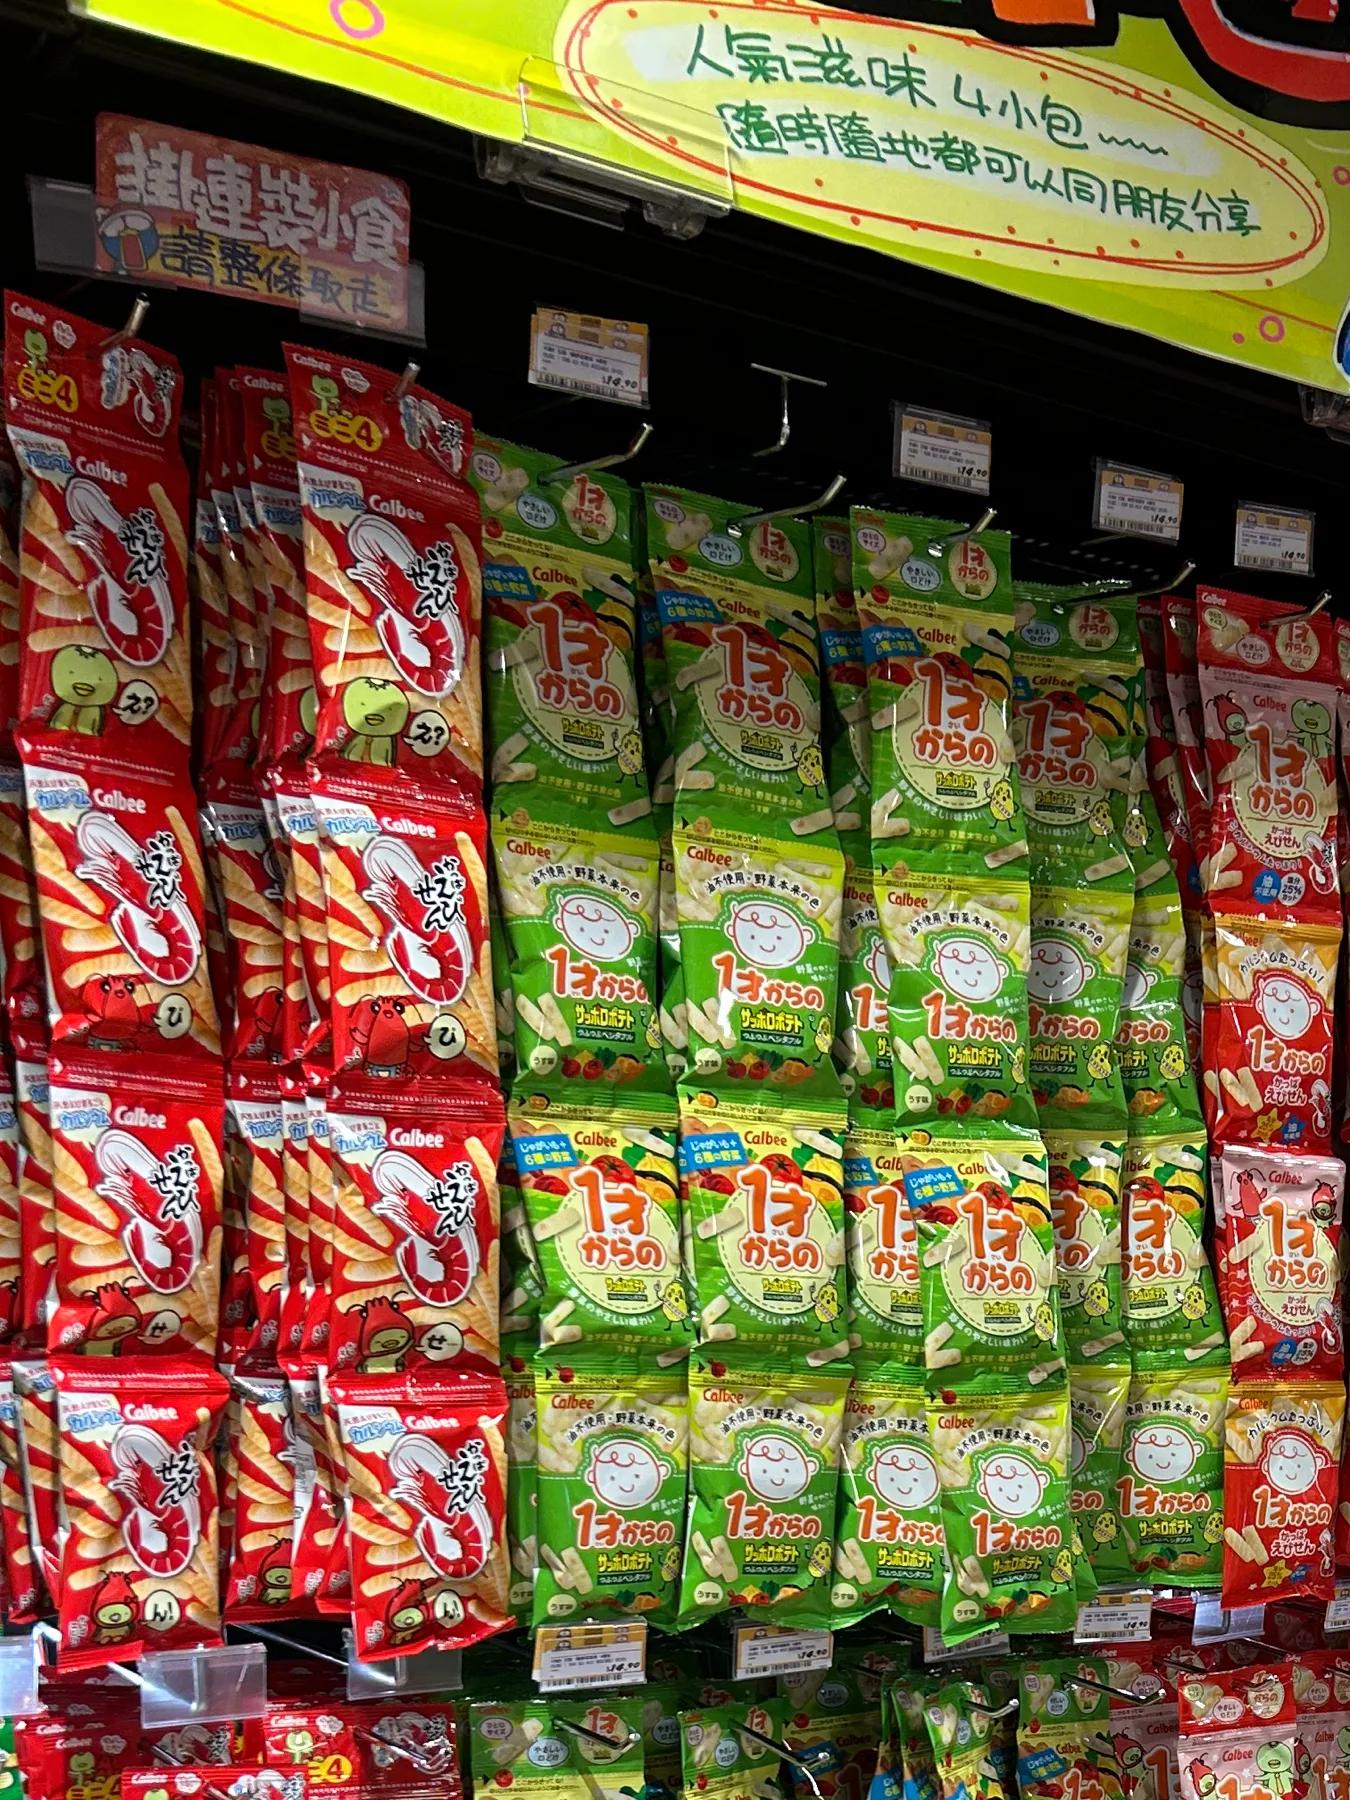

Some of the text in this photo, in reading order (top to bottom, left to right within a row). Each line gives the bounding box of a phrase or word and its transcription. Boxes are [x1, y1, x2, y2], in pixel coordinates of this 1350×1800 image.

[688, 24, 936, 107] 人氣滋味
[114, 131, 408, 273] 掛連裝小食
[160, 232, 391, 319] 請整條取走
[75, 455, 127, 487] Calbee
[368, 494, 424, 522] Calbee
[93, 788, 147, 814] Calbee
[380, 816, 437, 839] Calbee
[887, 892, 928, 907] Calbee
[740, 1008, 801, 1033] サッポロポテト
[114, 1105, 167, 1129] Calbee
[389, 1128, 445, 1149] Calbee
[1267, 1171, 1303, 1187] Calbee
[123, 1403, 179, 1422] Calbee
[404, 1415, 460, 1431] Calbee
